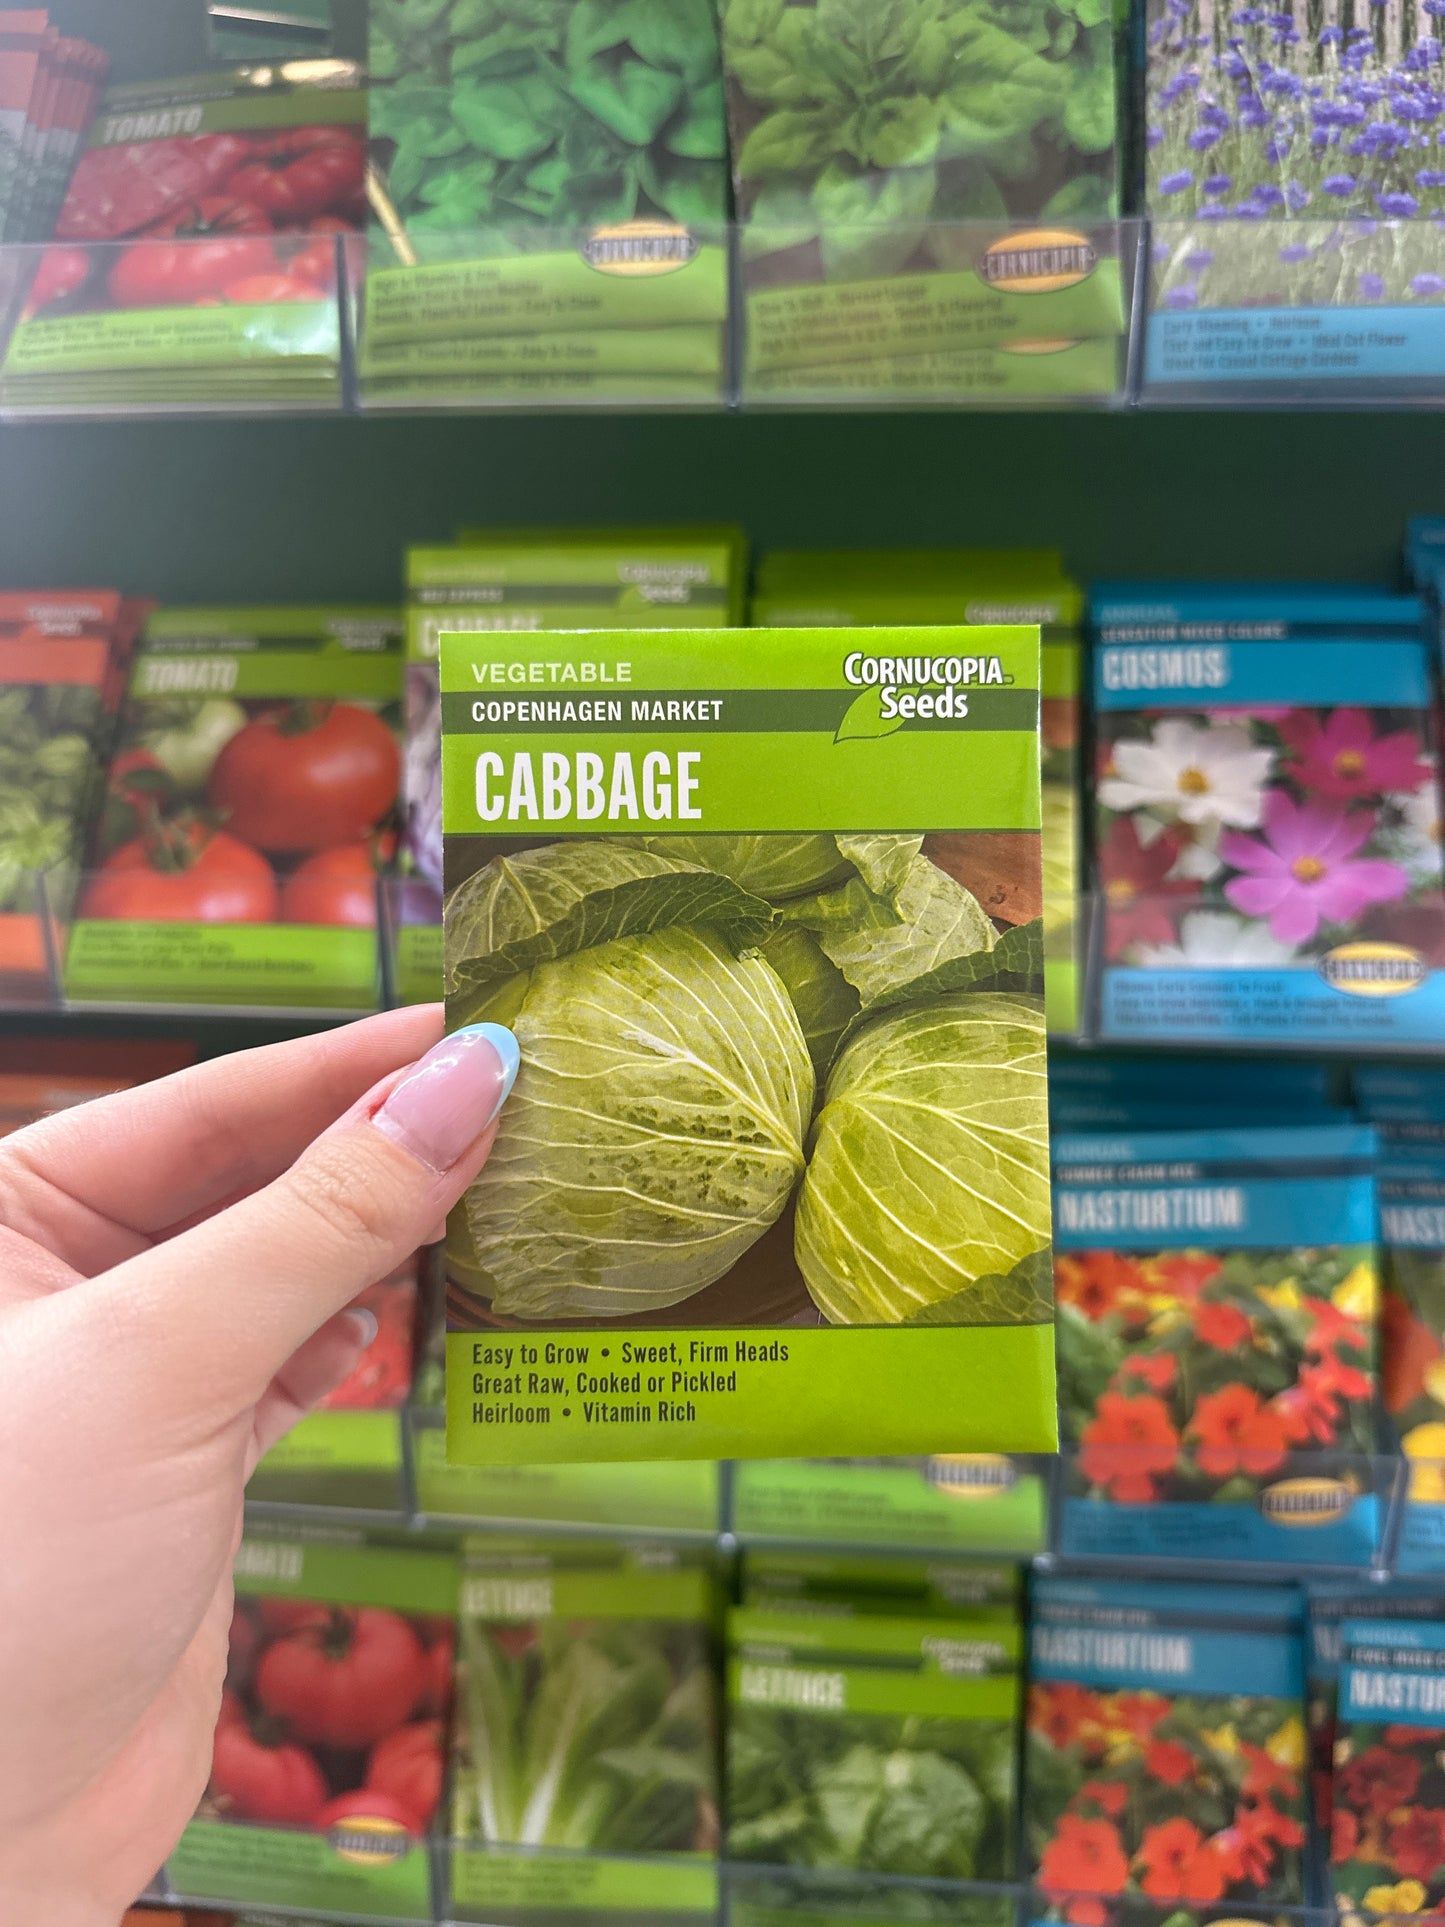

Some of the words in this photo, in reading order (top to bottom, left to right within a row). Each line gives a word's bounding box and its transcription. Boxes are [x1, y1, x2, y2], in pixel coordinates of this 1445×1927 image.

[103, 107, 204, 144] TOMATO
[143, 658, 239, 692] TOMATO
[471, 662, 632, 684] VEGETABLE
[844, 652, 1004, 685] CORNUCOPIA
[1103, 645, 1231, 690] COSMOS
[472, 700, 622, 722] COPENHAGEN
[631, 700, 724, 721] MARKET
[880, 685, 969, 719] Seeds
[475, 750, 702, 821] CABBAGE
[1058, 1187, 1245, 1231] NASTURTIUM
[472, 1343, 514, 1369] Easy
[520, 1344, 538, 1364] to
[545, 1343, 590, 1364] Grow
[621, 1342, 683, 1366] Sweet,
[689, 1341, 729, 1363] Firm
[735, 1340, 789, 1362] Heads
[472, 1373, 522, 1395] Great
[528, 1372, 570, 1397] Raw,
[576, 1371, 641, 1394] Cooked
[647, 1377, 666, 1393] or
[671, 1370, 737, 1392] Pickled
[472, 1402, 551, 1424] Heirloom
[583, 1401, 651, 1423] Vitamin
[658, 1400, 696, 1422] Rich
